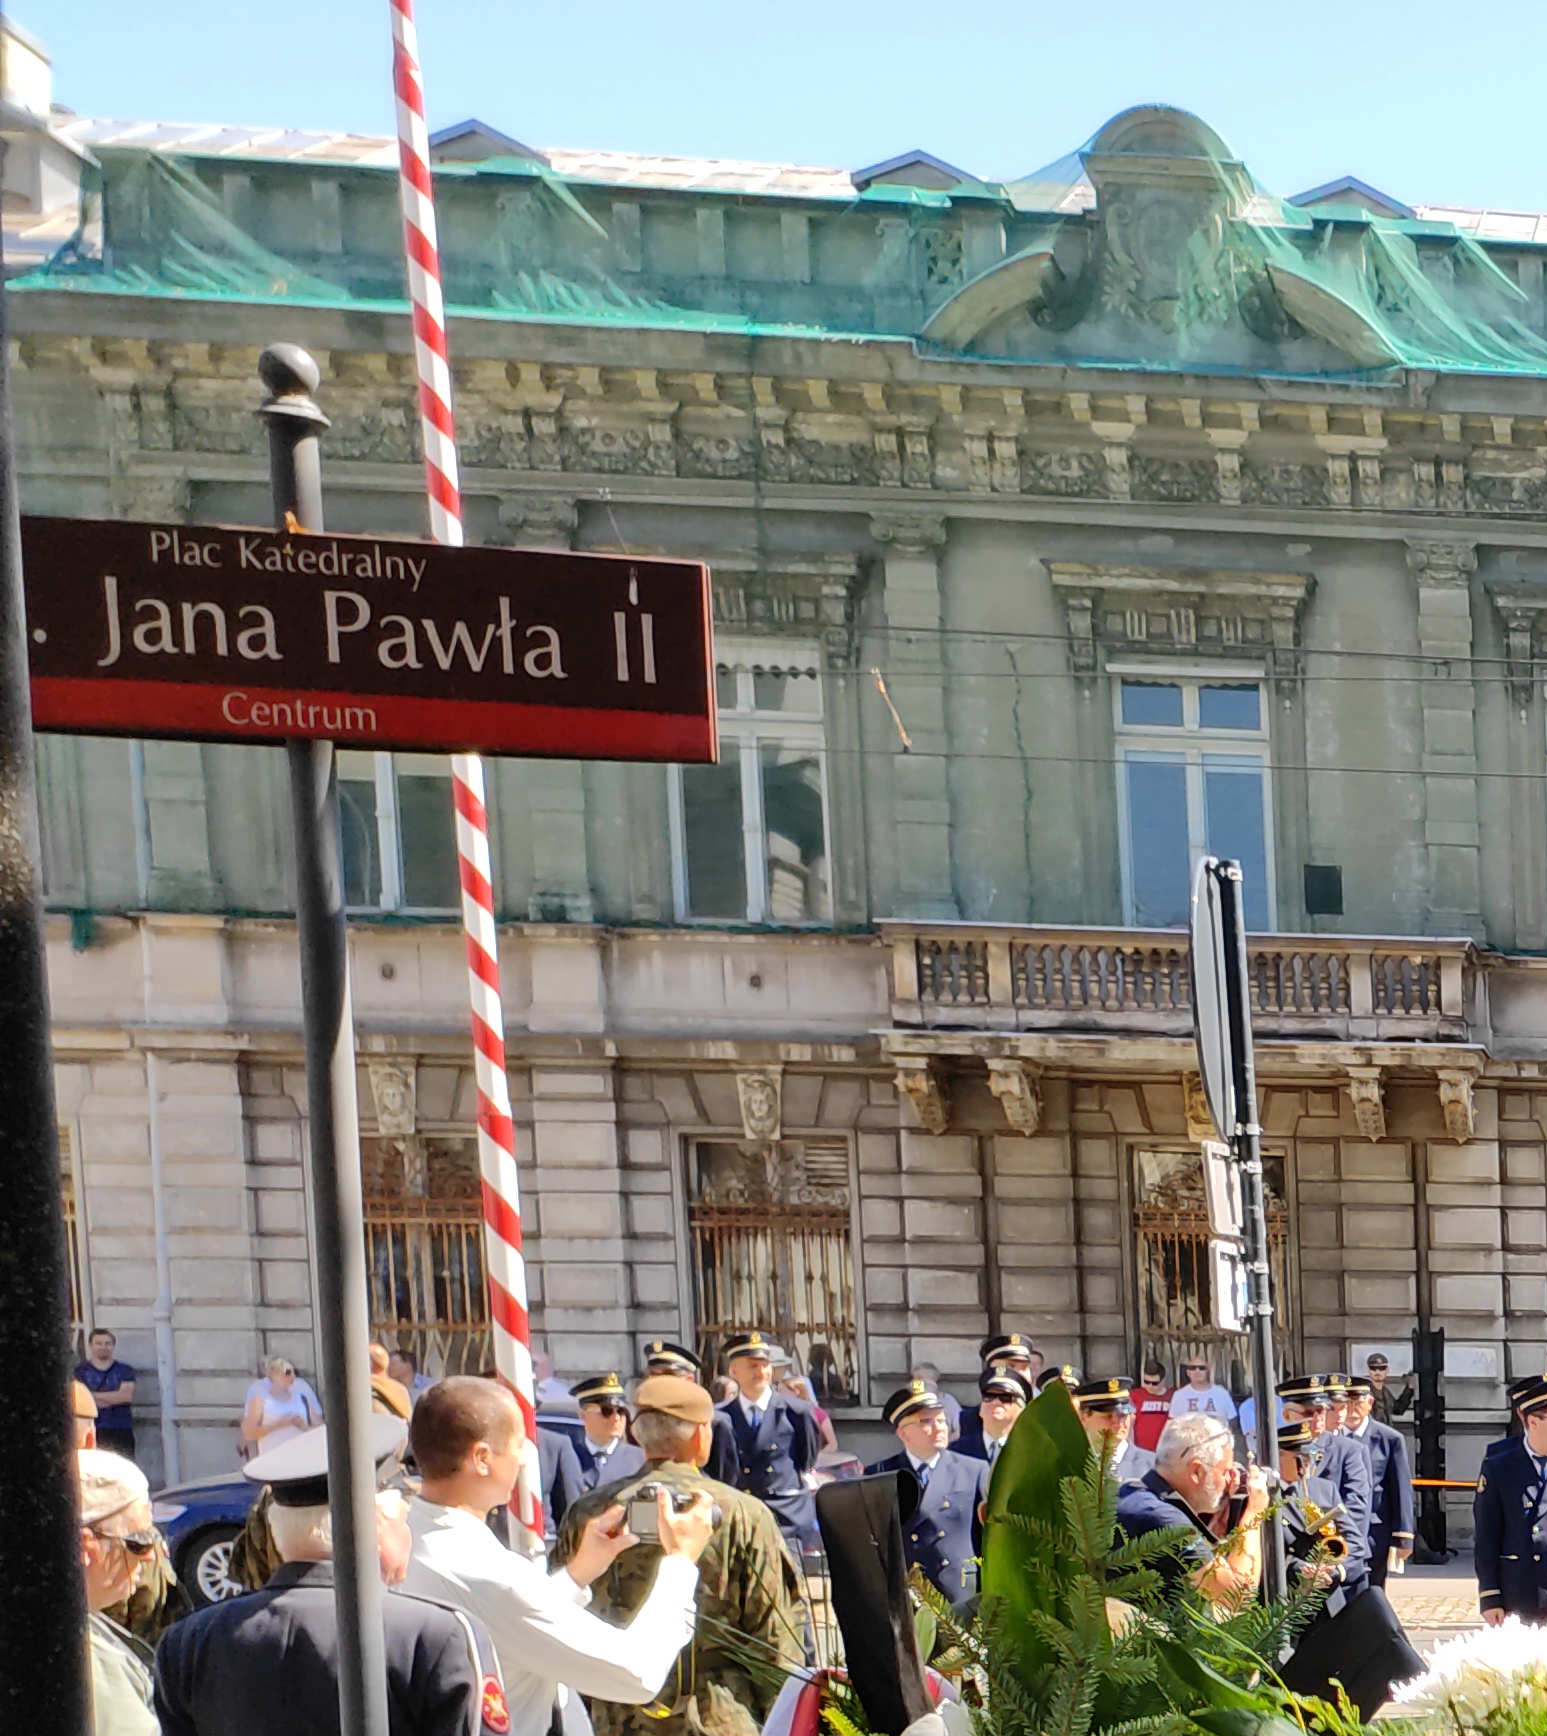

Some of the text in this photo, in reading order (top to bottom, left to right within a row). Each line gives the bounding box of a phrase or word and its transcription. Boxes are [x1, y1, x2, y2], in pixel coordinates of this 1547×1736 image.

[150, 529, 428, 593] Plac Katedralny
[97, 575, 659, 685] Jana Pawła II
[221, 690, 379, 733] Centrum
